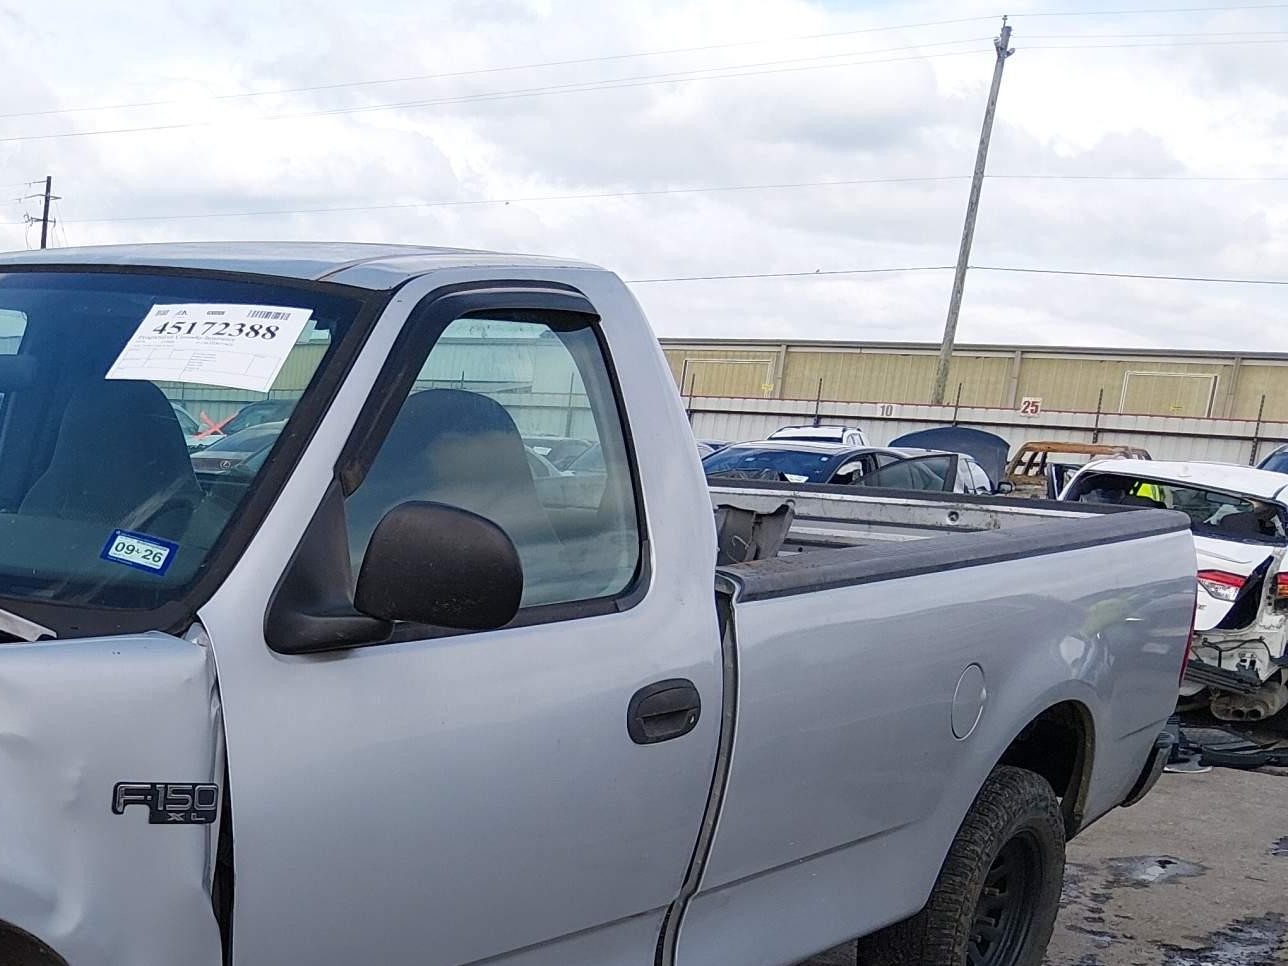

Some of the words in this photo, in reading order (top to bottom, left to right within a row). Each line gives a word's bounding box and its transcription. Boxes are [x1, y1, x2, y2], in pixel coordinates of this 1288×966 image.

[152, 321, 280, 340] 45172388
[879, 404, 894, 417] 10
[1021, 400, 1040, 415] 25
[114, 541, 136, 555] 09
[141, 548, 164, 563] 26
[167, 812, 206, 821] XL
